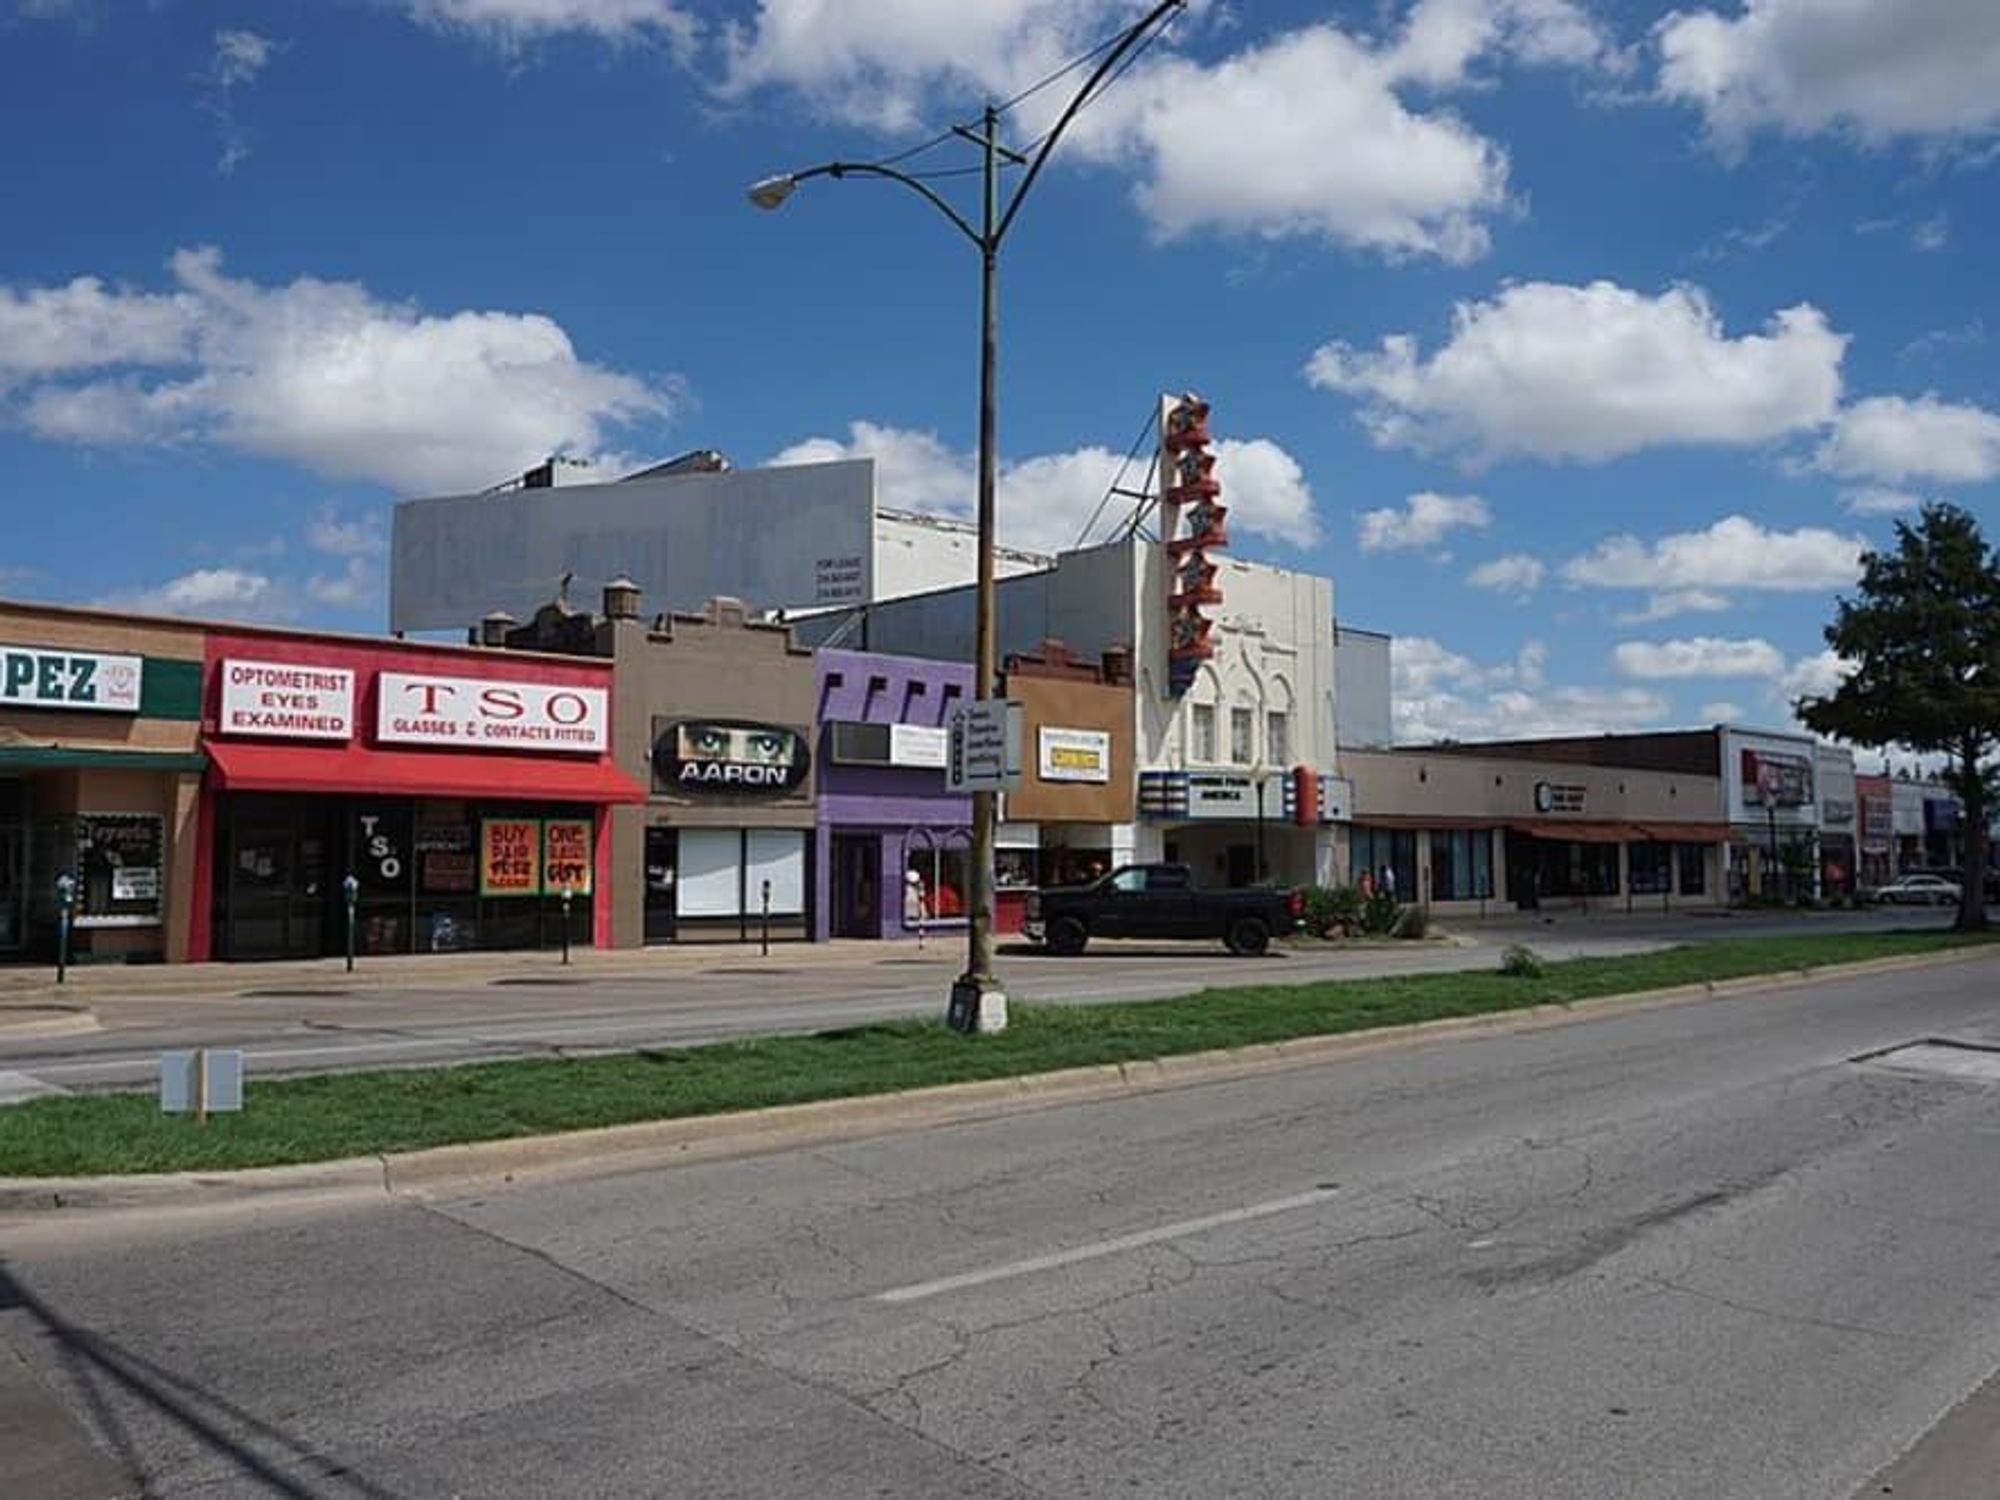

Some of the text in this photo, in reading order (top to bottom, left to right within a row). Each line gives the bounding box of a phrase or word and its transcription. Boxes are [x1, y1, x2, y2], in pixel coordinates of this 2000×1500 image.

[231, 667, 348, 692] OPTOMETRIST
[261, 692, 319, 709] EYES
[232, 711, 344, 731] EXAMINED
[393, 719, 457, 735] GLASSES
[484, 724, 551, 740] CONTACTS
[554, 726, 596, 742] FITTED
[679, 762, 788, 784] AARON
[492, 823, 531, 843] BUY
